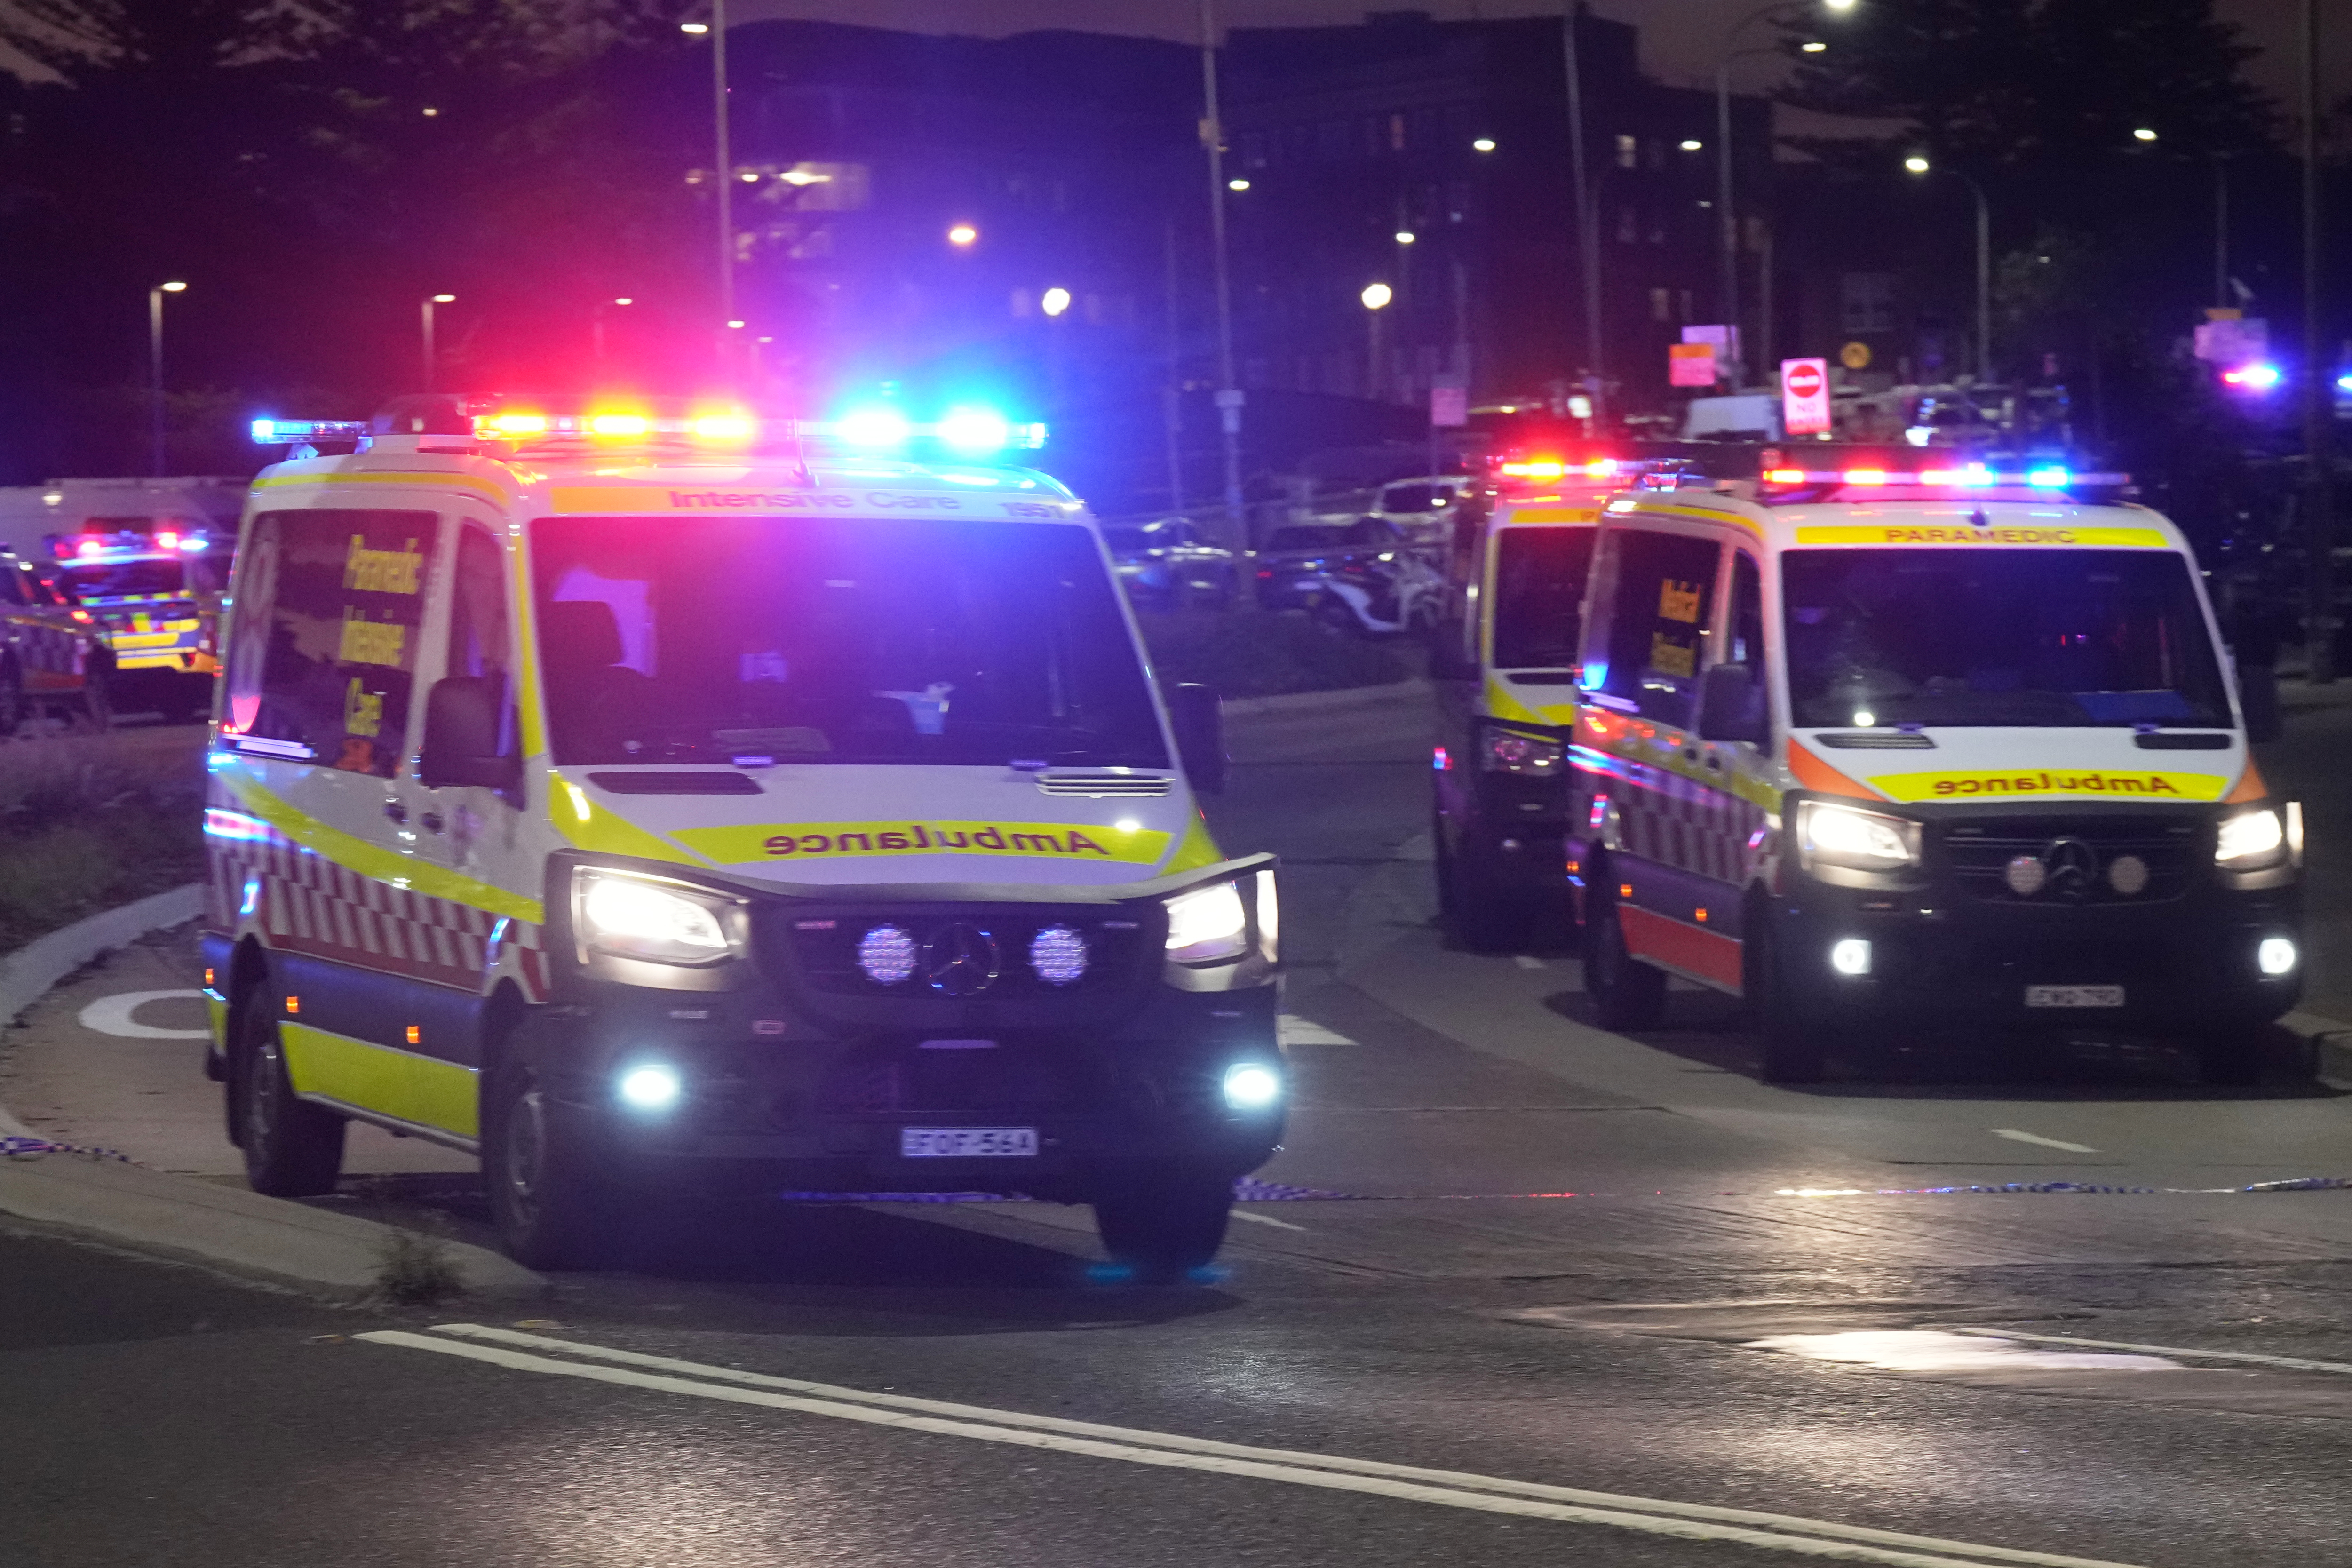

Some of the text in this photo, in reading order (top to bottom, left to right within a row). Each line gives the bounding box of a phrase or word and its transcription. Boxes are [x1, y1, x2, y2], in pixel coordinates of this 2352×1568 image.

[669, 491, 961, 509] Intensive Care
[1886, 529, 2076, 544] PARAMEDIC
